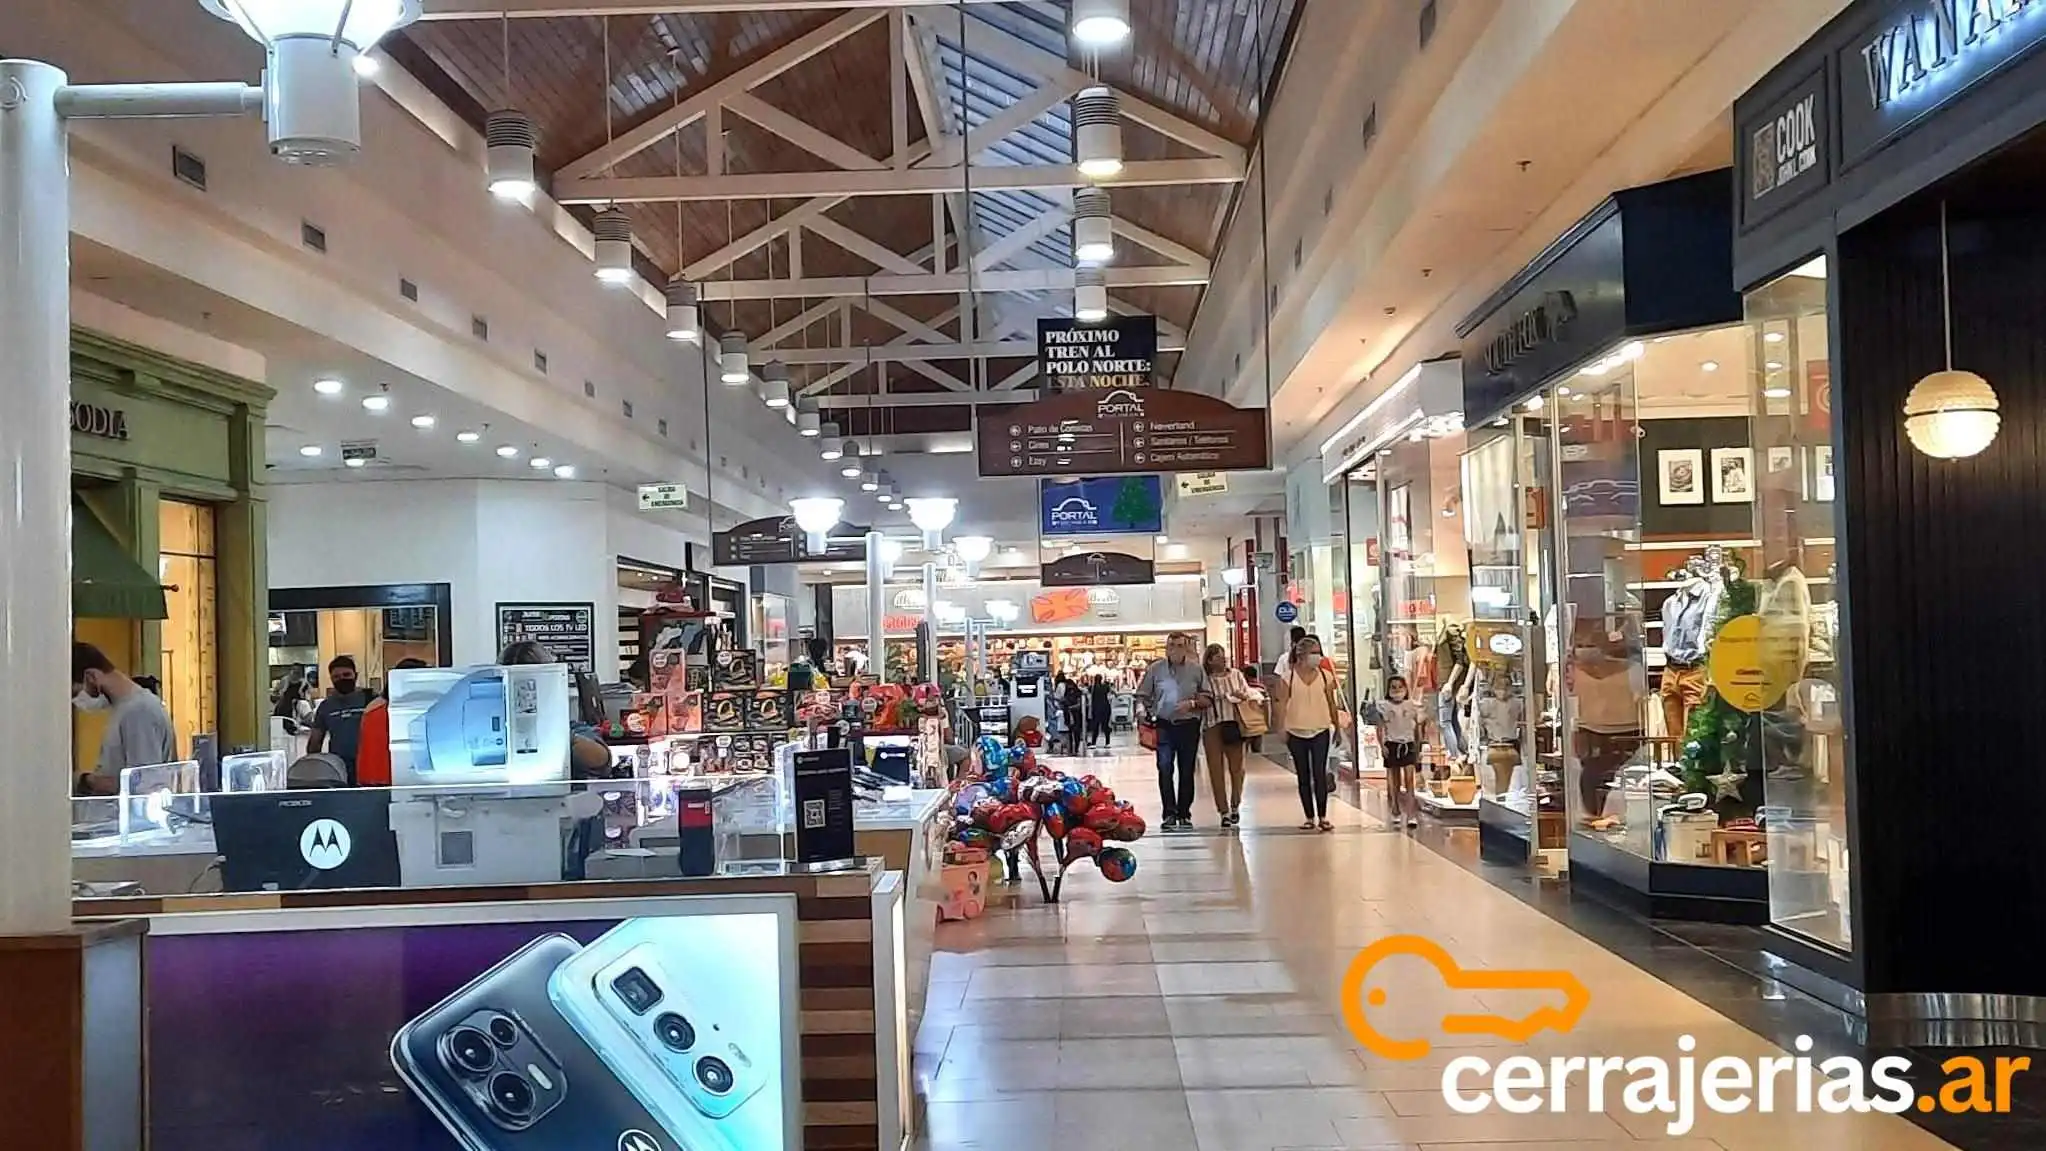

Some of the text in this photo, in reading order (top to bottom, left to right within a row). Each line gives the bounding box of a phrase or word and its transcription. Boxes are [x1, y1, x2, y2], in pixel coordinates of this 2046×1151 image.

[1776, 93, 1816, 163] COOK
[1045, 327, 1120, 343] PRÓXIMO
[1045, 344, 1116, 359] TREN AL
[1046, 359, 1152, 374] POLO NORTE:
[1097, 403, 1145, 414] PORTAL
[1051, 511, 1098, 521] PORTAL
